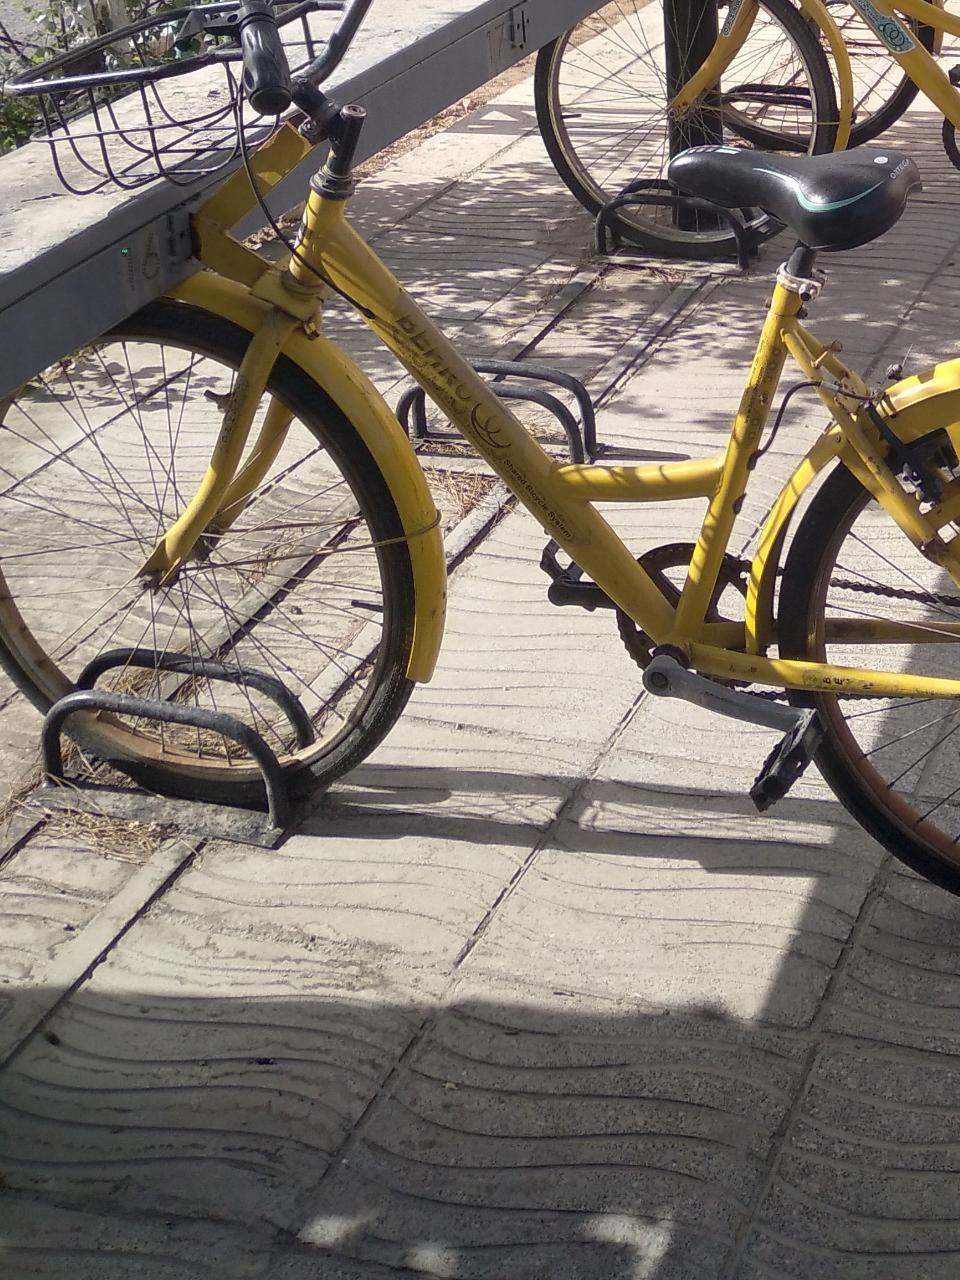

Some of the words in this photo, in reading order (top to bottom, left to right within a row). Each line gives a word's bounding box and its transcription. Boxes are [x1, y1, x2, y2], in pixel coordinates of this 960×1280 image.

[503, 458, 528, 486] Shared
[525, 484, 550, 512] Bicycle
[547, 507, 572, 538] System
